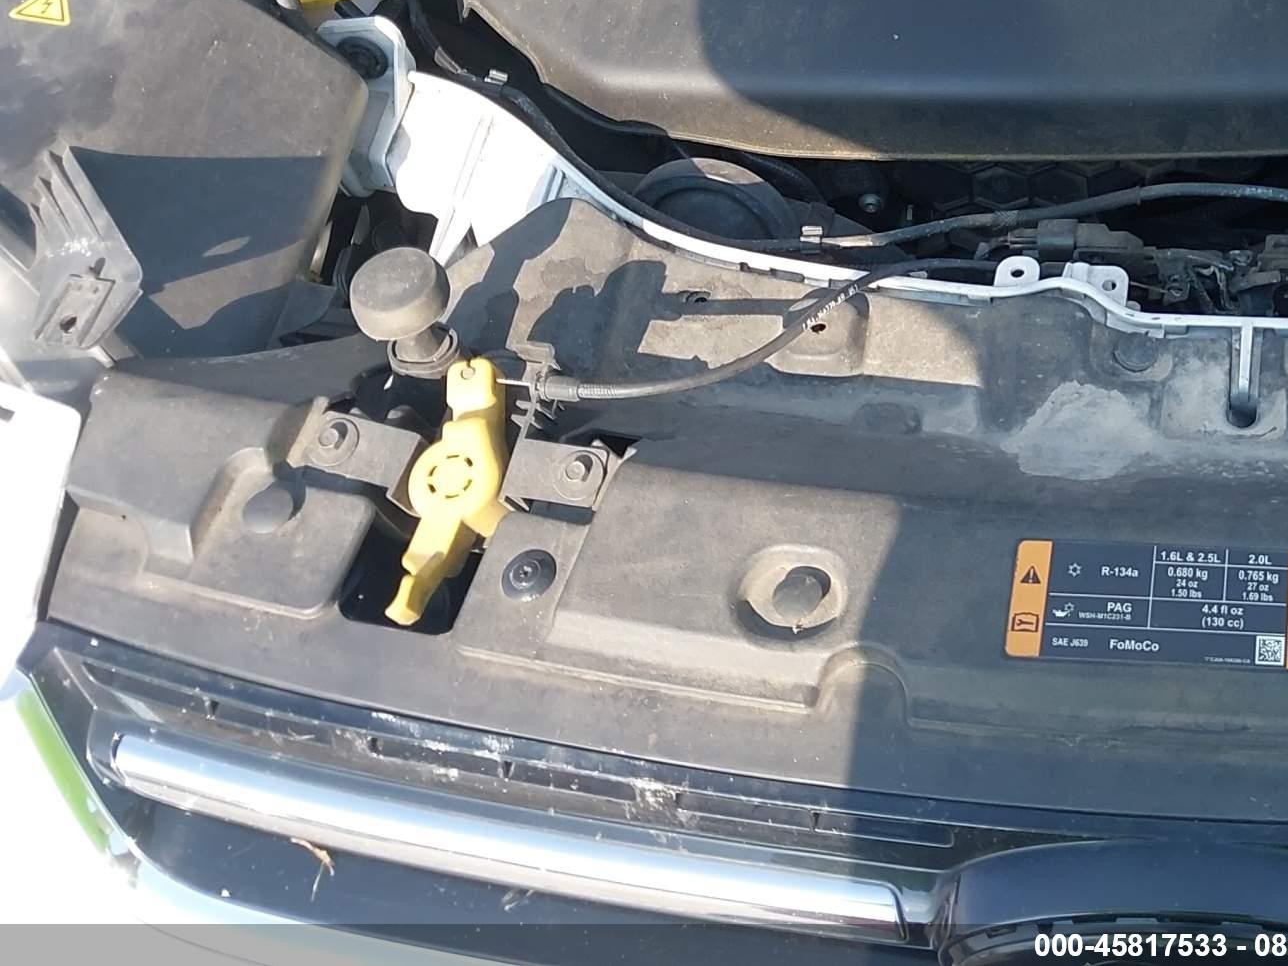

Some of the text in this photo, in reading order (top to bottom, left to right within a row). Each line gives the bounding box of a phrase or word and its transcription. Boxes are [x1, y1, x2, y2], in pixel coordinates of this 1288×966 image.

[1160, 550, 1222, 563] 1.6L & 2.5L
[1248, 554, 1272, 565] 2.0L
[1100, 565, 1139, 578] R-134a
[1167, 566, 1208, 581] 0.680 kg
[1238, 569, 1279, 584] 0.765 kg
[1176, 578, 1198, 588] 24 oz
[1247, 582, 1270, 591] 27 oz
[1171, 588, 1202, 599] 1.50 lbs
[1242, 592, 1273, 602] 1.69 lbs
[1106, 601, 1132, 613] PAG
[1201, 604, 1244, 616] 4.4 fl oz
[1201, 616, 1244, 630] (130 cc)
[1051, 637, 1068, 647] SAE
[1109, 639, 1160, 652] FoMoCo
